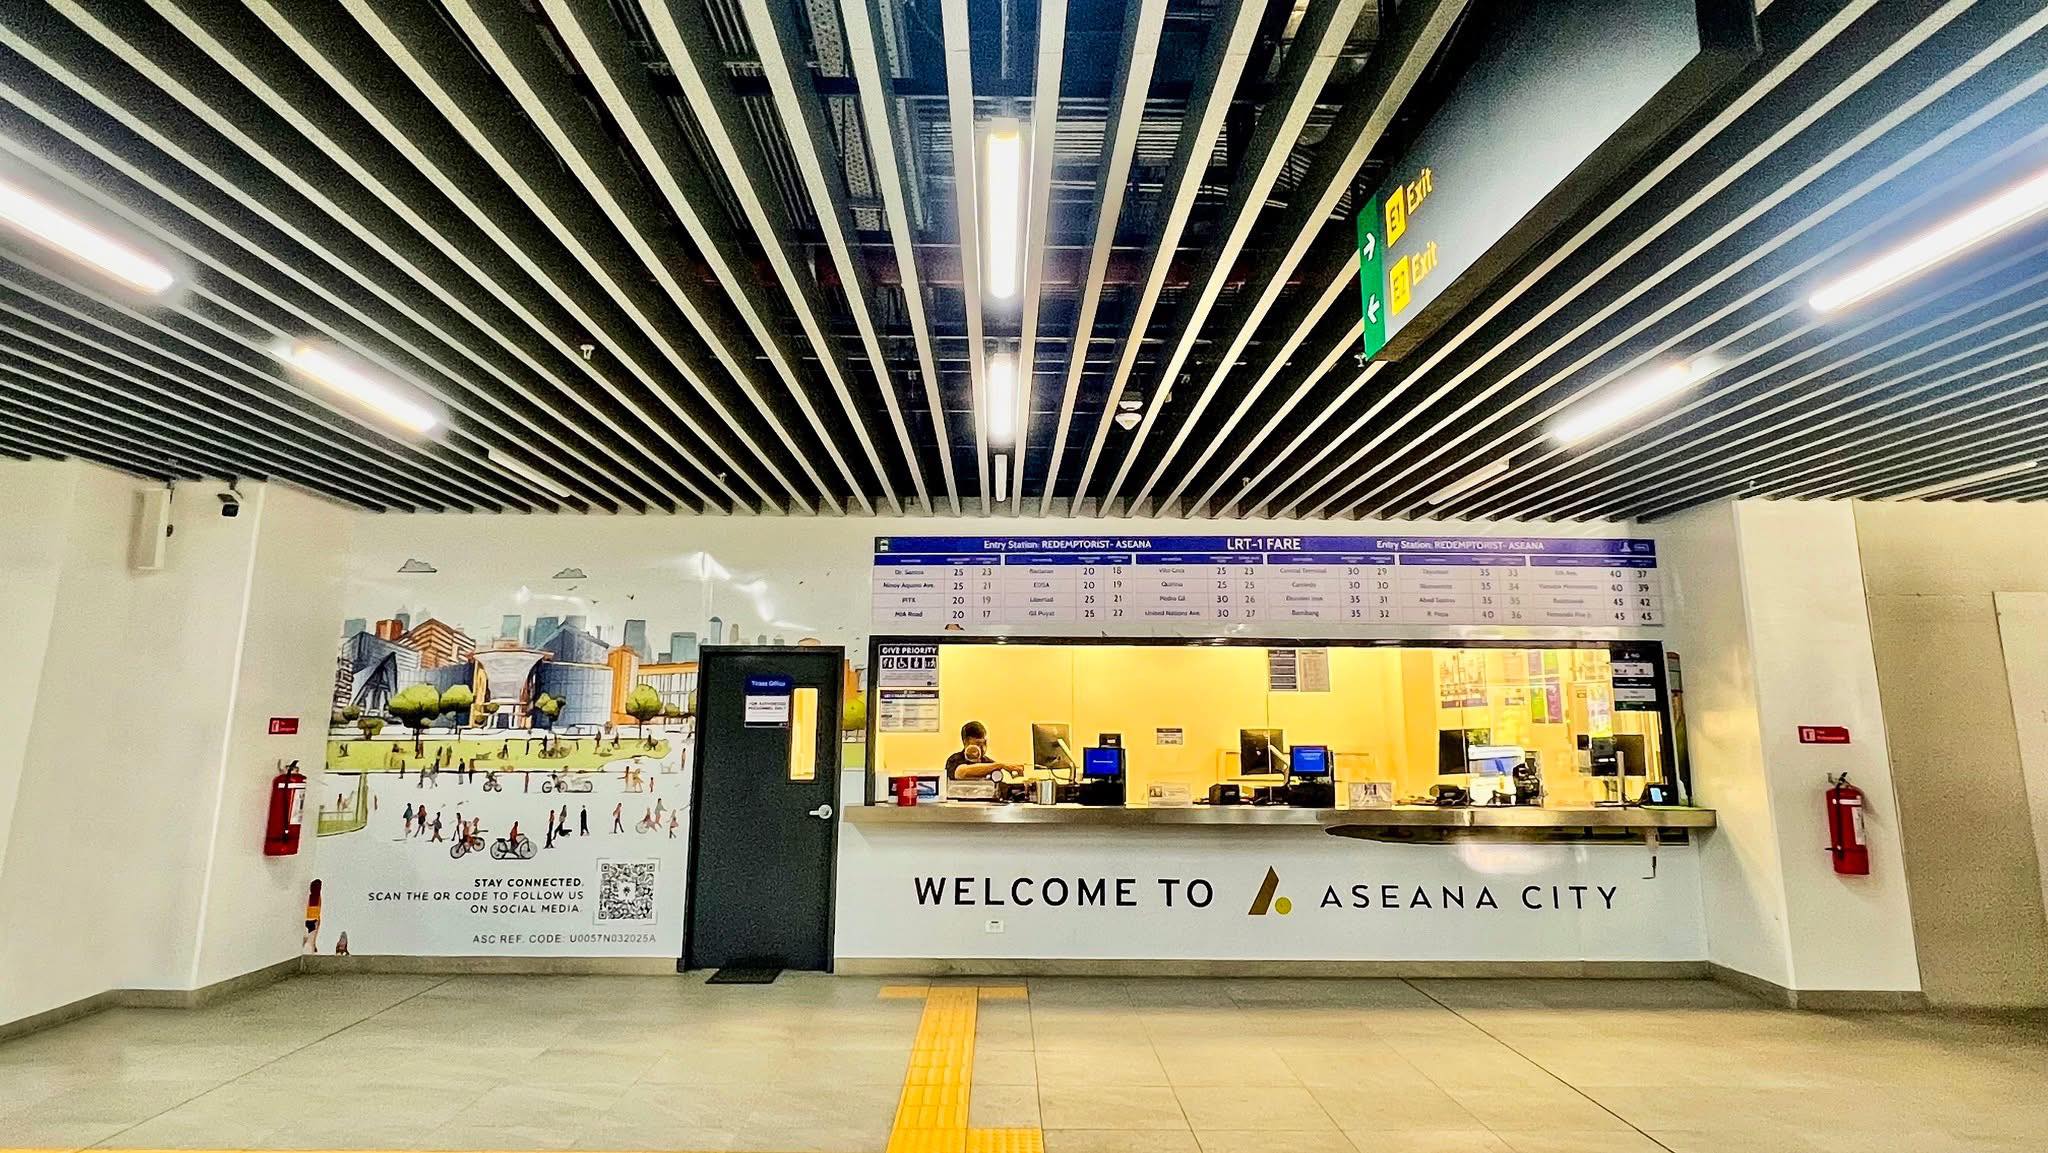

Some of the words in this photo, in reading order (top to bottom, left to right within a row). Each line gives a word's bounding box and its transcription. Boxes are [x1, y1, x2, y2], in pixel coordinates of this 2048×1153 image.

[1390, 204, 1402, 232] E1
[1406, 167, 1433, 216] Exit
[1412, 240, 1438, 286] Exit
[984, 541, 1005, 551] Entry
[1116, 540, 1151, 549] ASEANA
[1227, 538, 1262, 550] LRT-1
[1267, 538, 1301, 550] FARE
[1376, 541, 1399, 550] Entry
[1509, 541, 1544, 550] ASEANA
[474, 879, 502, 887] STAY
[507, 878, 584, 887] CONNECTED.
[368, 892, 401, 900] SCAN
[407, 892, 429, 900] THE
[433, 892, 450, 900] QR
[455, 892, 488, 900] CODE
[493, 892, 508, 900] TO
[513, 891, 563, 900] FOLLOW
[569, 891, 584, 899] US
[914, 877, 1138, 906] WELCOME
[1158, 878, 1213, 908] TO
[1320, 884, 1498, 909] ASEANA
[1521, 886, 1616, 910] CITY
[471, 905, 488, 913] ON
[493, 905, 536, 913] SOCIAL
[541, 904, 582, 913] MEDIA.
[473, 935, 496, 944] ASC
[500, 935, 525, 944] REF.
[529, 934, 565, 943] CODE:
